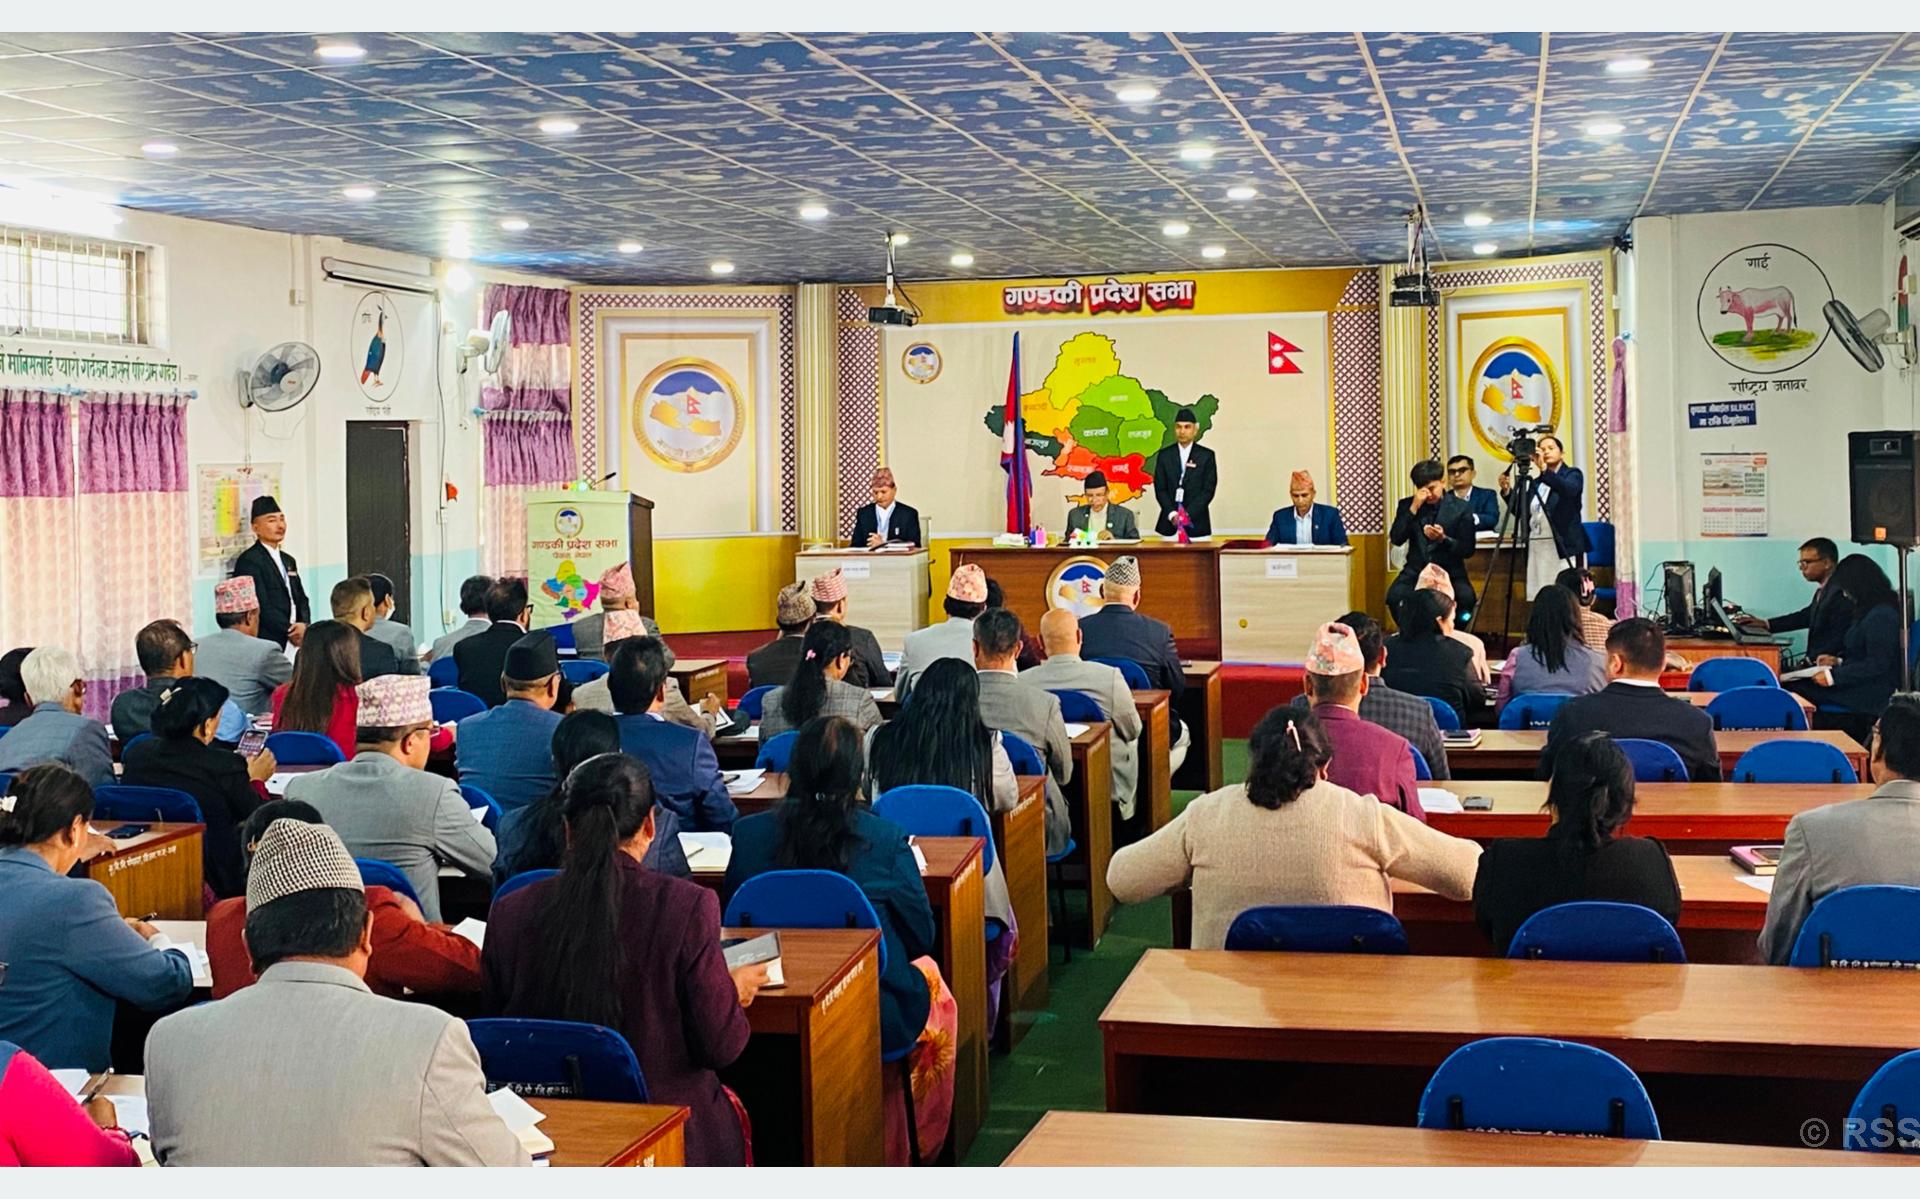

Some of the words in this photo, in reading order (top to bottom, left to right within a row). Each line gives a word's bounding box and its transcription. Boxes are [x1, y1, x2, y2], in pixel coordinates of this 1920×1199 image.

[1745, 252, 1771, 270] गाई
[1004, 280, 1083, 308] गण्डकी
[1088, 278, 1142, 307] प्रदेश
[1147, 280, 1194, 304] सभा
[1730, 403, 1754, 412] SILENCE
[532, 538, 564, 549] गण्डकी
[567, 538, 591, 550] प्रदेश
[595, 539, 618, 548] सभा
